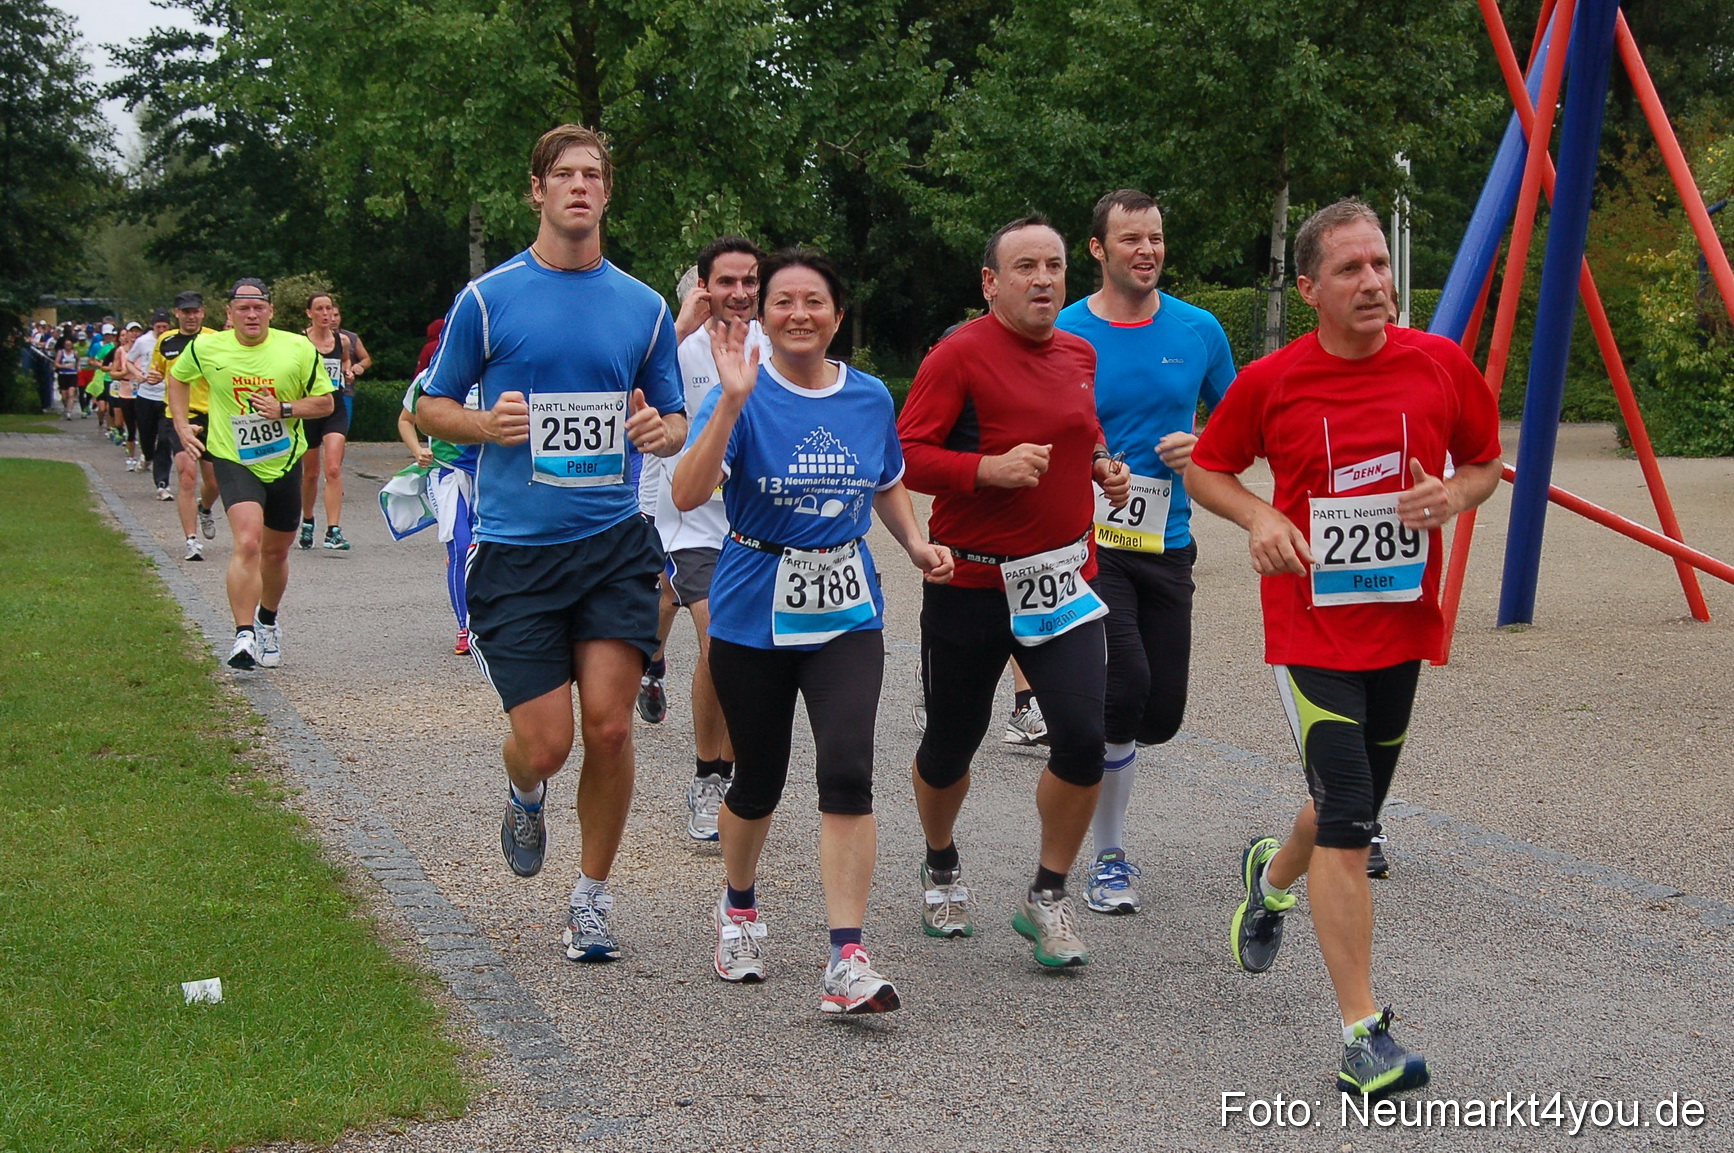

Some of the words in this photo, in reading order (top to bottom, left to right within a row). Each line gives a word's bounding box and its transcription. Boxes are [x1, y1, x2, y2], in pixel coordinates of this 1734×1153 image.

[324, 366, 338, 378] 37
[232, 376, 275, 386] Müller
[532, 403, 566, 412] PARTL
[568, 402, 613, 411] Neumarkt
[238, 420, 283, 446] 2489
[541, 415, 616, 451] 2531
[567, 460, 598, 474] Peter
[1353, 463, 1383, 481] DEHN
[757, 476, 789, 495] 13.
[785, 476, 840, 486] Neumarkter
[1129, 484, 1160, 496] umarkt
[1107, 496, 1147, 527] 29
[1313, 509, 1350, 520] PARTL
[1098, 528, 1142, 548] Michael
[1323, 521, 1420, 565] 2289
[783, 555, 815, 572] PARTL
[967, 553, 996, 564] mara
[1005, 565, 1040, 581] PARTL
[786, 564, 860, 609] 3188
[1353, 574, 1395, 589] Peter
